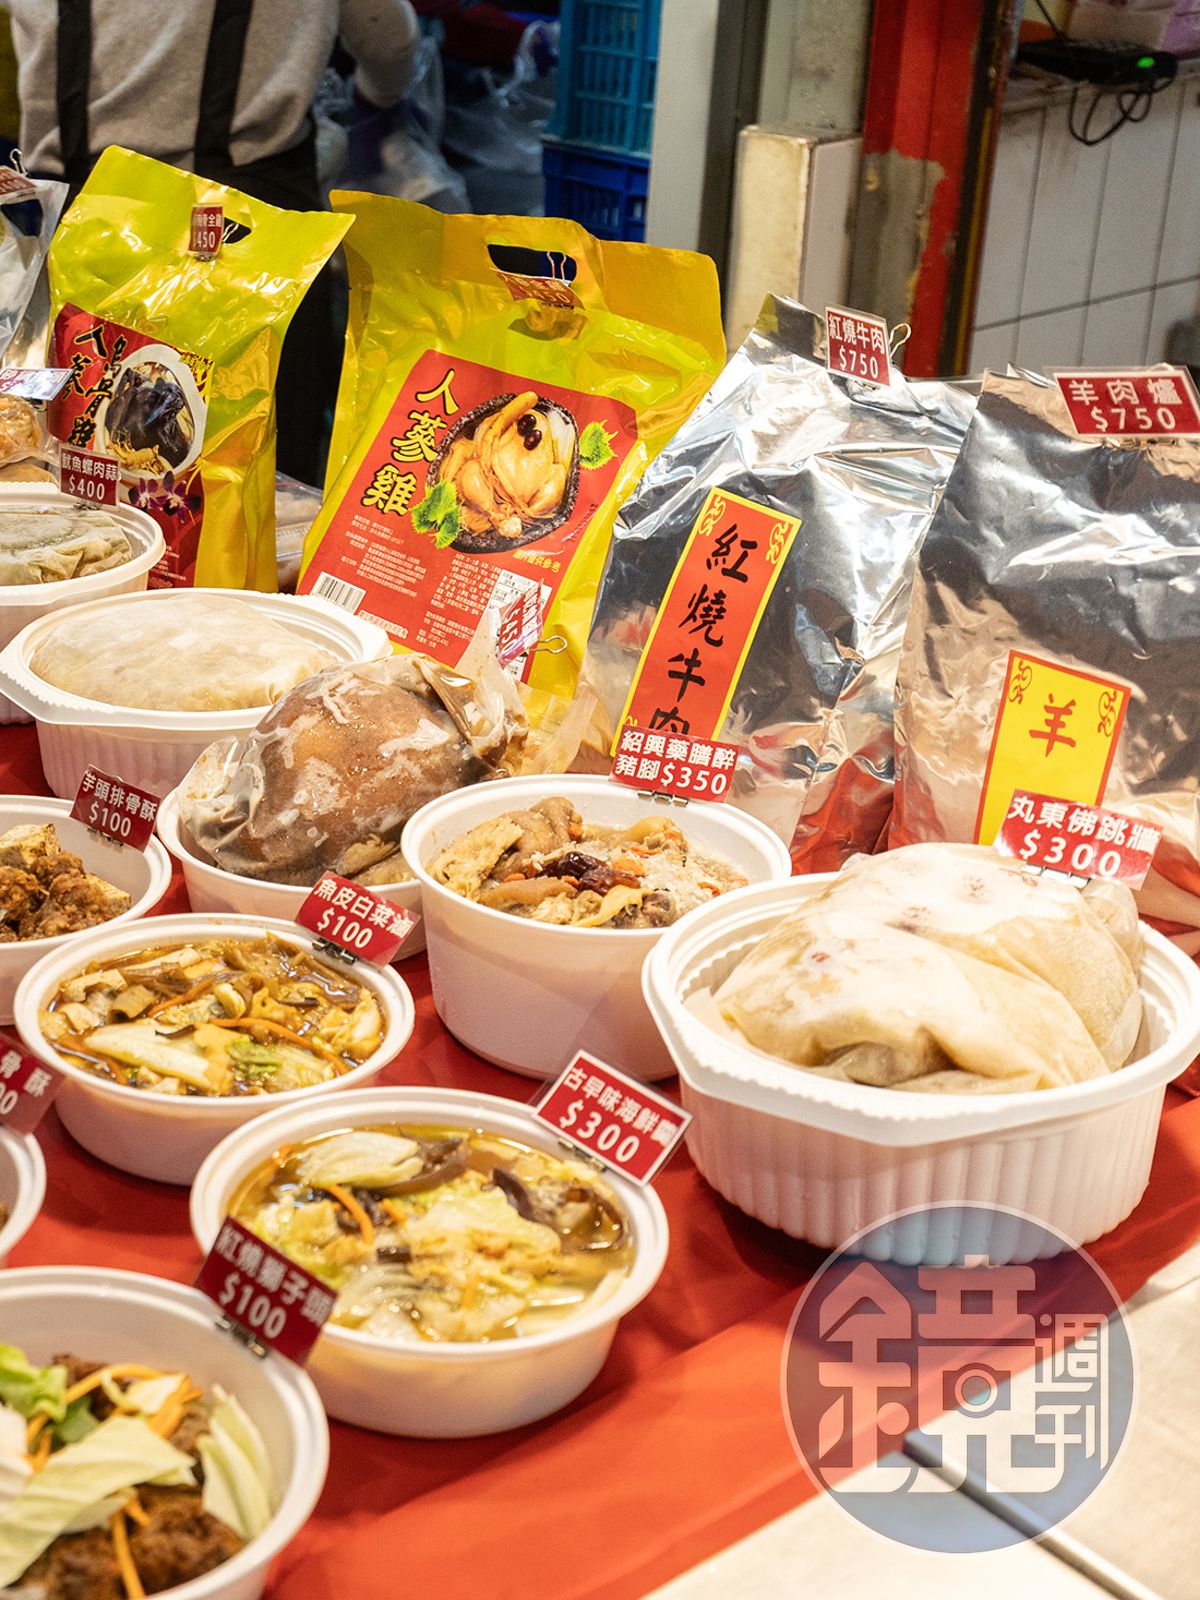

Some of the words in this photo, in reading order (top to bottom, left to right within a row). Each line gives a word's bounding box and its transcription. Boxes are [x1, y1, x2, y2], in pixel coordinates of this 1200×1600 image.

[828, 313, 885, 354] 紅燒牛肉
[839, 345, 879, 379] $750
[1068, 378, 1183, 406] 羊肉爐
[1090, 406, 1176, 432] $750
[61, 453, 118, 481] 魷魚螺肉蒜
[68, 474, 106, 500] $400
[648, 523, 758, 735] 紅燒牛肉
[1028, 692, 1077, 758] 羊
[620, 730, 737, 771] 紹興藥膳醉
[82, 771, 158, 822] 芋頭排骨酥
[88, 801, 132, 837] $100
[1006, 796, 1162, 854] 丸東佛跳牆
[1018, 829, 1122, 878] $300
[313, 878, 414, 939] 魚皮白菜滷
[316, 907, 373, 948] $100
[558, 1099, 641, 1163] $300
[563, 1066, 680, 1147] 古早味海鮮羹
[213, 1225, 335, 1328] 紅燒獅子頭
[217, 1270, 287, 1340] $100
